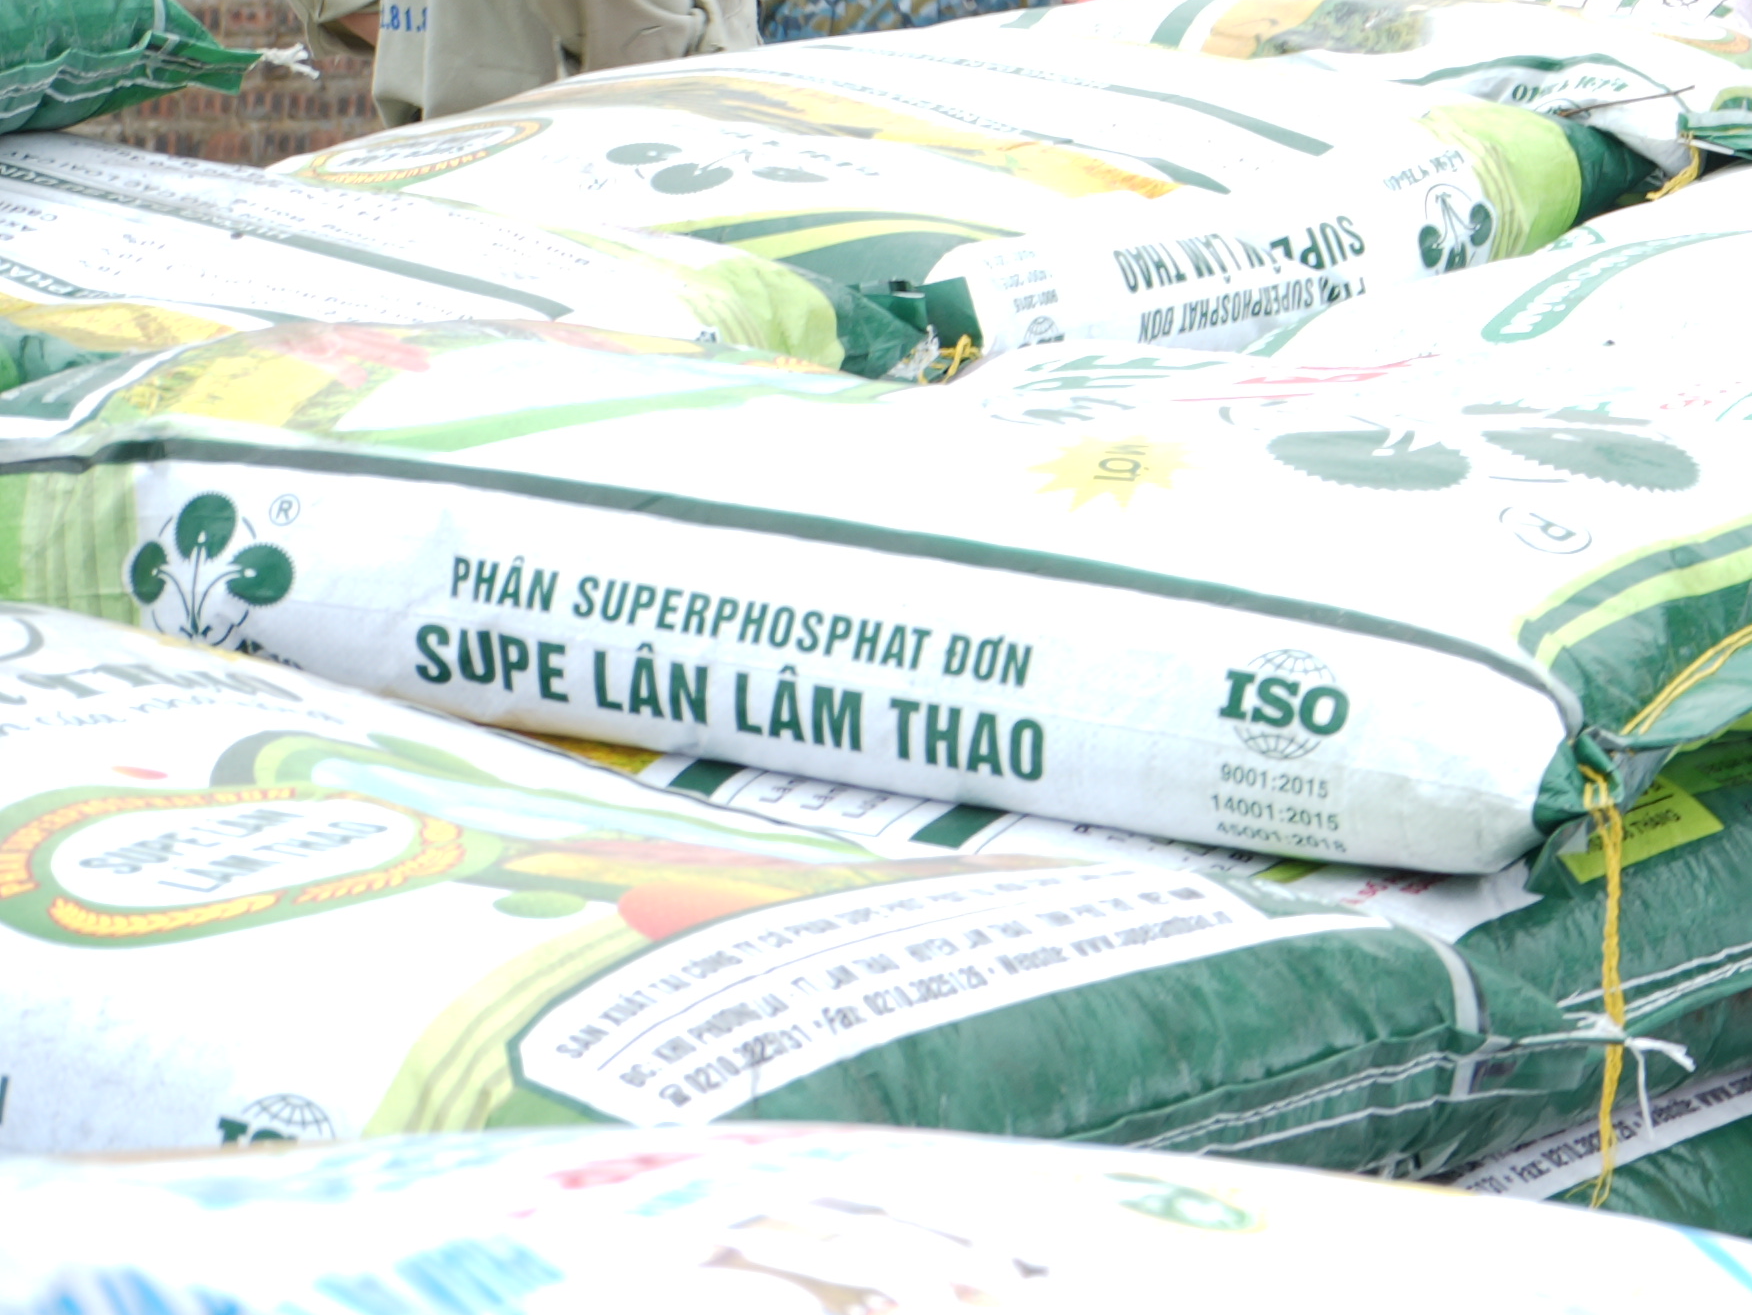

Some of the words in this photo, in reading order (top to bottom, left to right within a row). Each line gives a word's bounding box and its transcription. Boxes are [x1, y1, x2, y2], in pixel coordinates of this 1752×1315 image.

[1177, 276, 1316, 334] SUPERPHOSPHAT
[447, 553, 561, 615] PHÂN
[572, 573, 931, 674] SUPERPHOSPHAT
[943, 628, 1033, 689] ĐƠN
[413, 621, 570, 705] SUPE
[593, 637, 709, 727] LÂN
[734, 662, 863, 756] LÂM
[888, 695, 1047, 785] THAO
[1218, 667, 1352, 739] ISO
[1209, 791, 1342, 834] 14001:2015
[1219, 762, 1331, 800] 9001:2015
